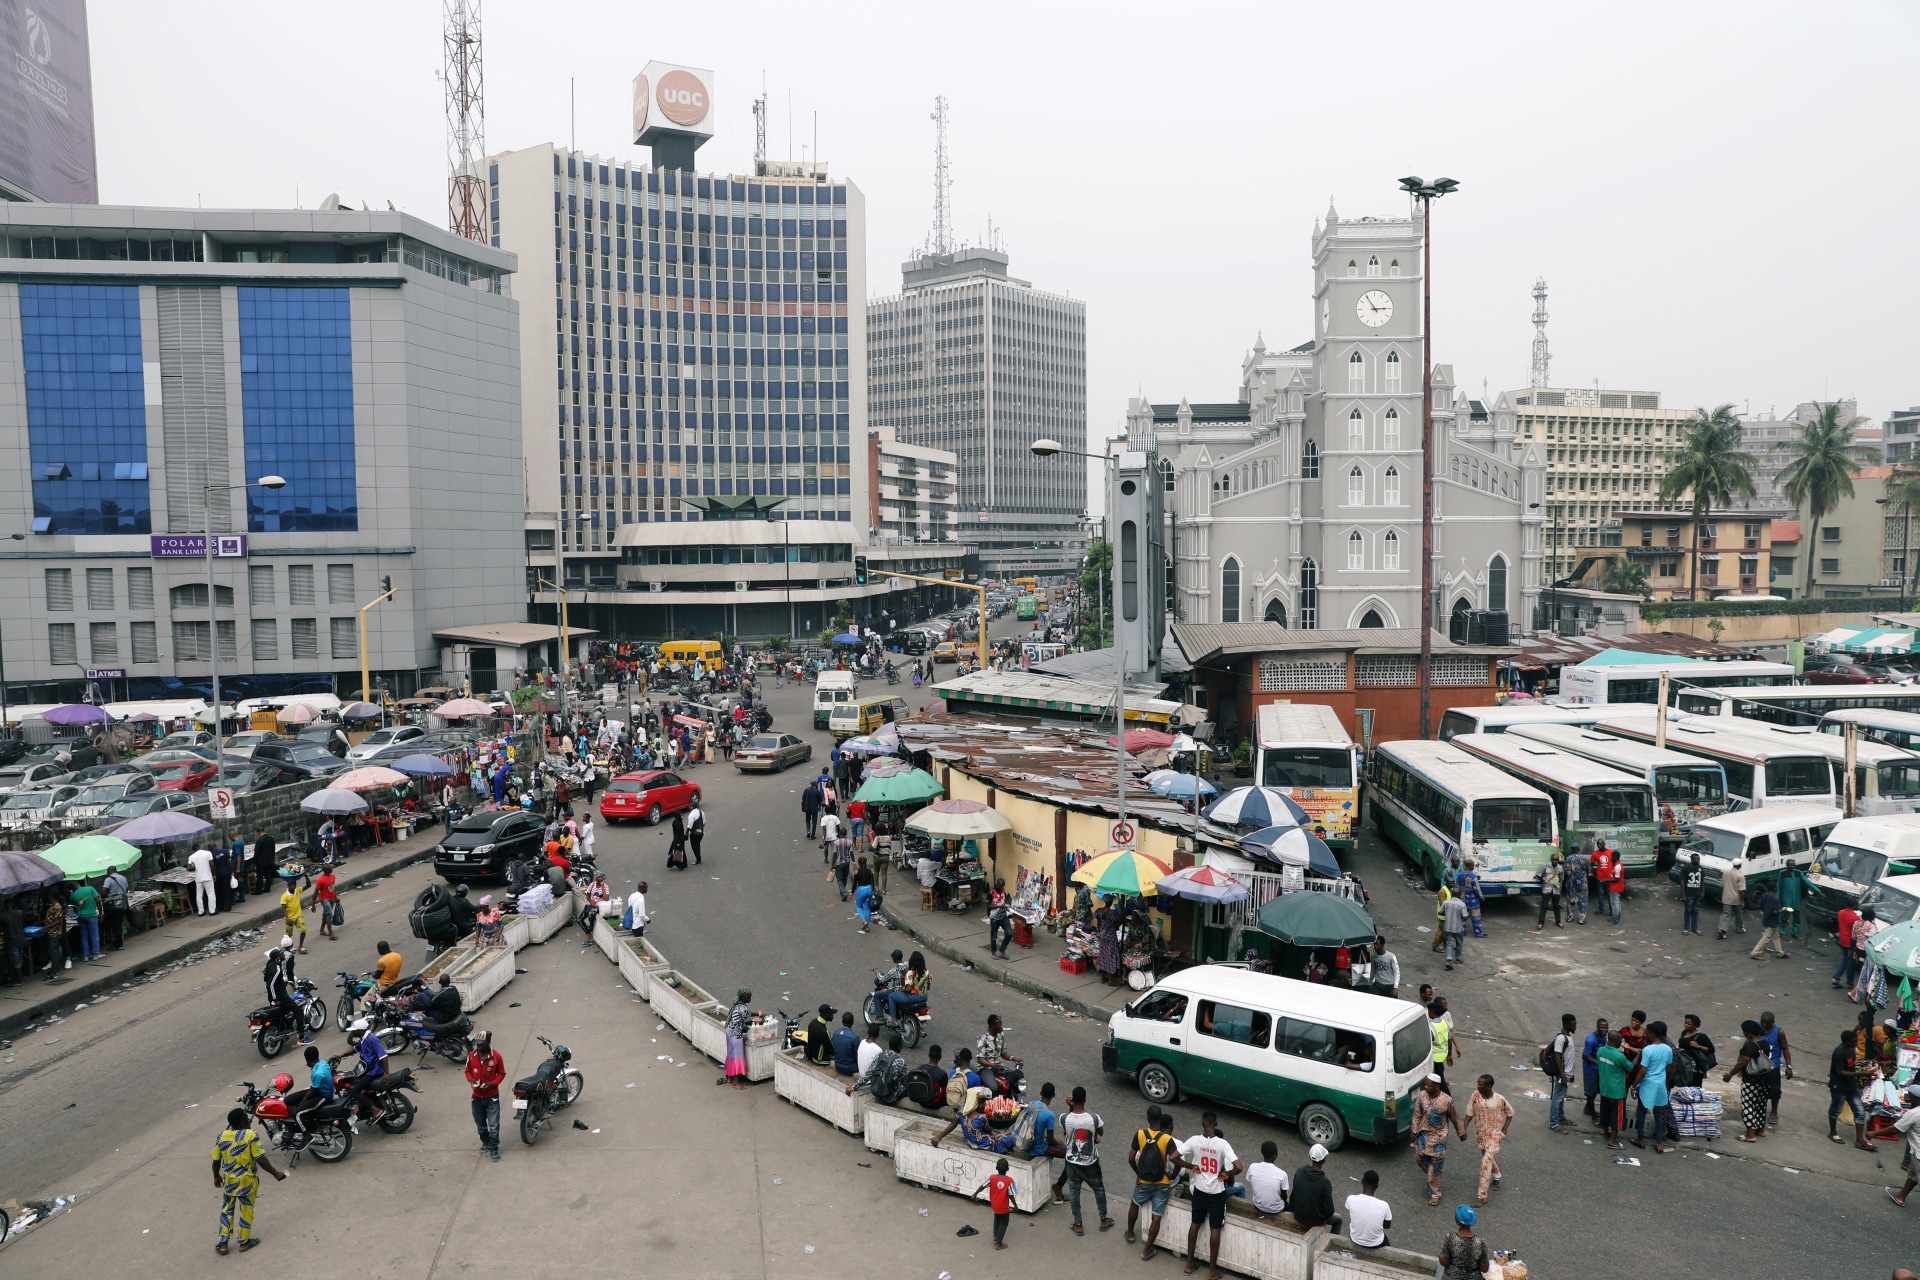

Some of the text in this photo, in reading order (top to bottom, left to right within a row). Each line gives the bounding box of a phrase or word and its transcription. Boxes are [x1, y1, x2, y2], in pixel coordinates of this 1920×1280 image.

[20, 60, 65, 98] DARLING
[664, 87, 703, 107] uac
[1565, 388, 1599, 399] CHURCH
[1566, 399, 1596, 407] HOUSE
[161, 539, 218, 547] POLARS
[98, 670, 114, 678] ATM
[1687, 871, 1702, 884] 33
[944, 1157, 977, 1180] CBD
[1201, 1156, 1218, 1174] 99
